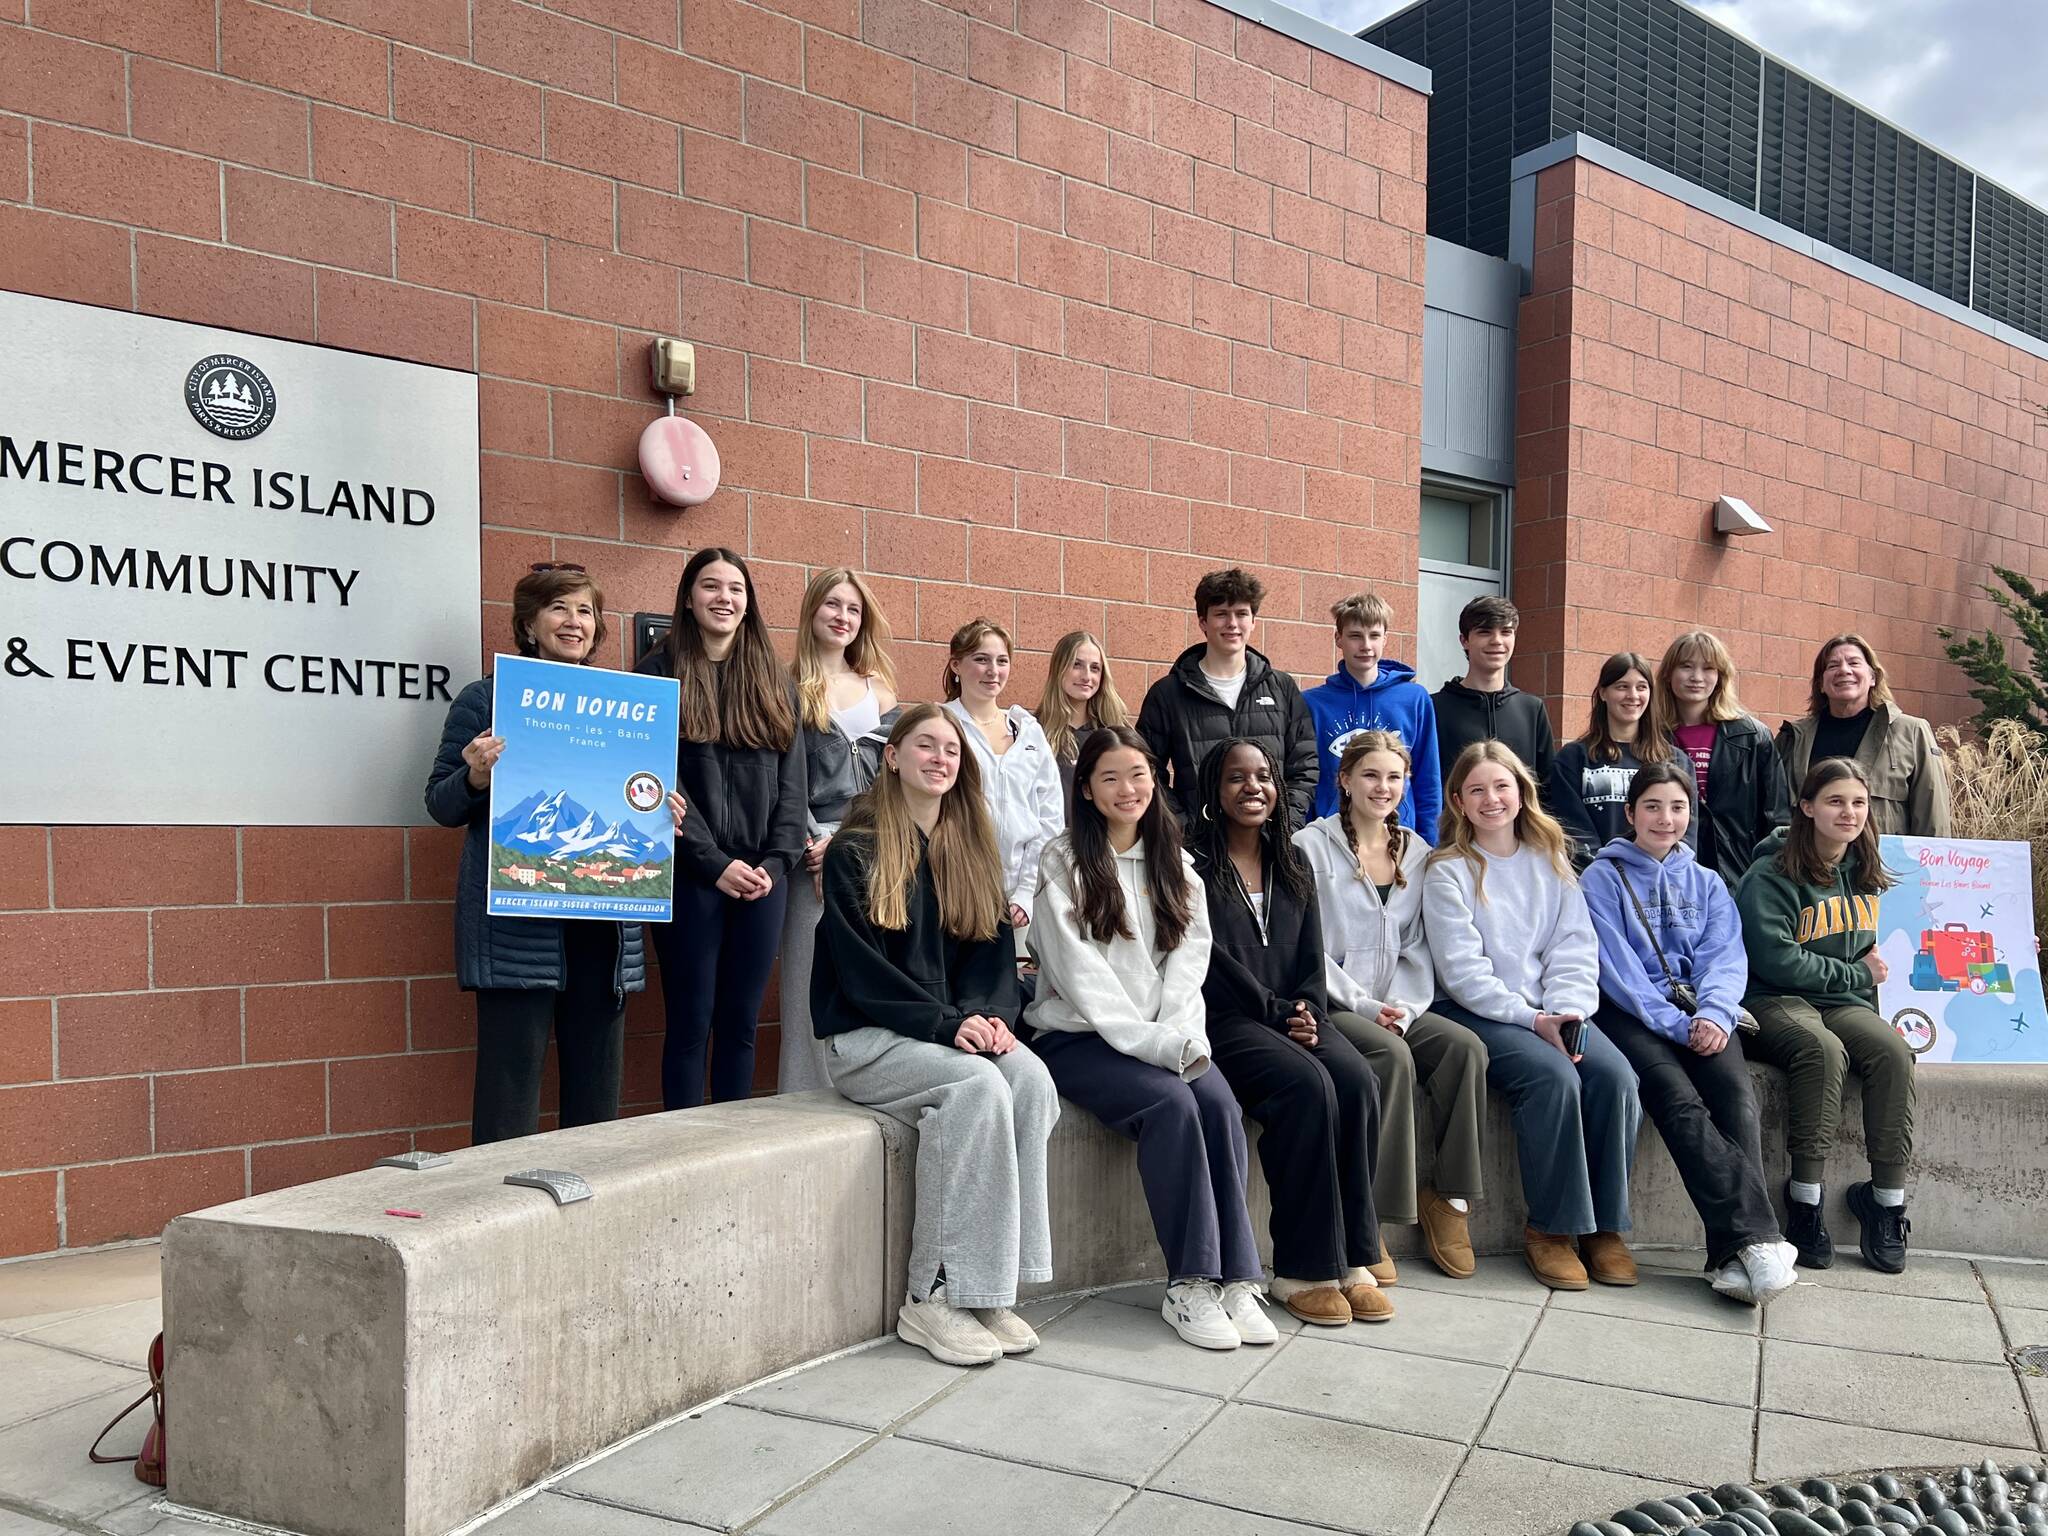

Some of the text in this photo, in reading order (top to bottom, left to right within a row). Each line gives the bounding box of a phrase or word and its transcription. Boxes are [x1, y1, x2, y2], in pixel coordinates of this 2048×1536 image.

[188, 357, 274, 403] CITY OF MERCER ISLAND
[191, 402, 271, 437] PARKS & RECREATION
[0, 435, 436, 526] MERCER ISLAND
[0, 536, 360, 606] COMMUNITY
[4, 636, 453, 701] & EVENT CENTER
[520, 688, 658, 722] BON VOYAGE
[524, 717, 571, 731] Thonon
[585, 724, 603, 735] les
[617, 728, 651, 741] Bains
[569, 736, 607, 748] France
[1919, 848, 1991, 875] Bon Voyage
[494, 897, 665, 913] MERCER ISLAND SISTER CITY ASSOCIATION
